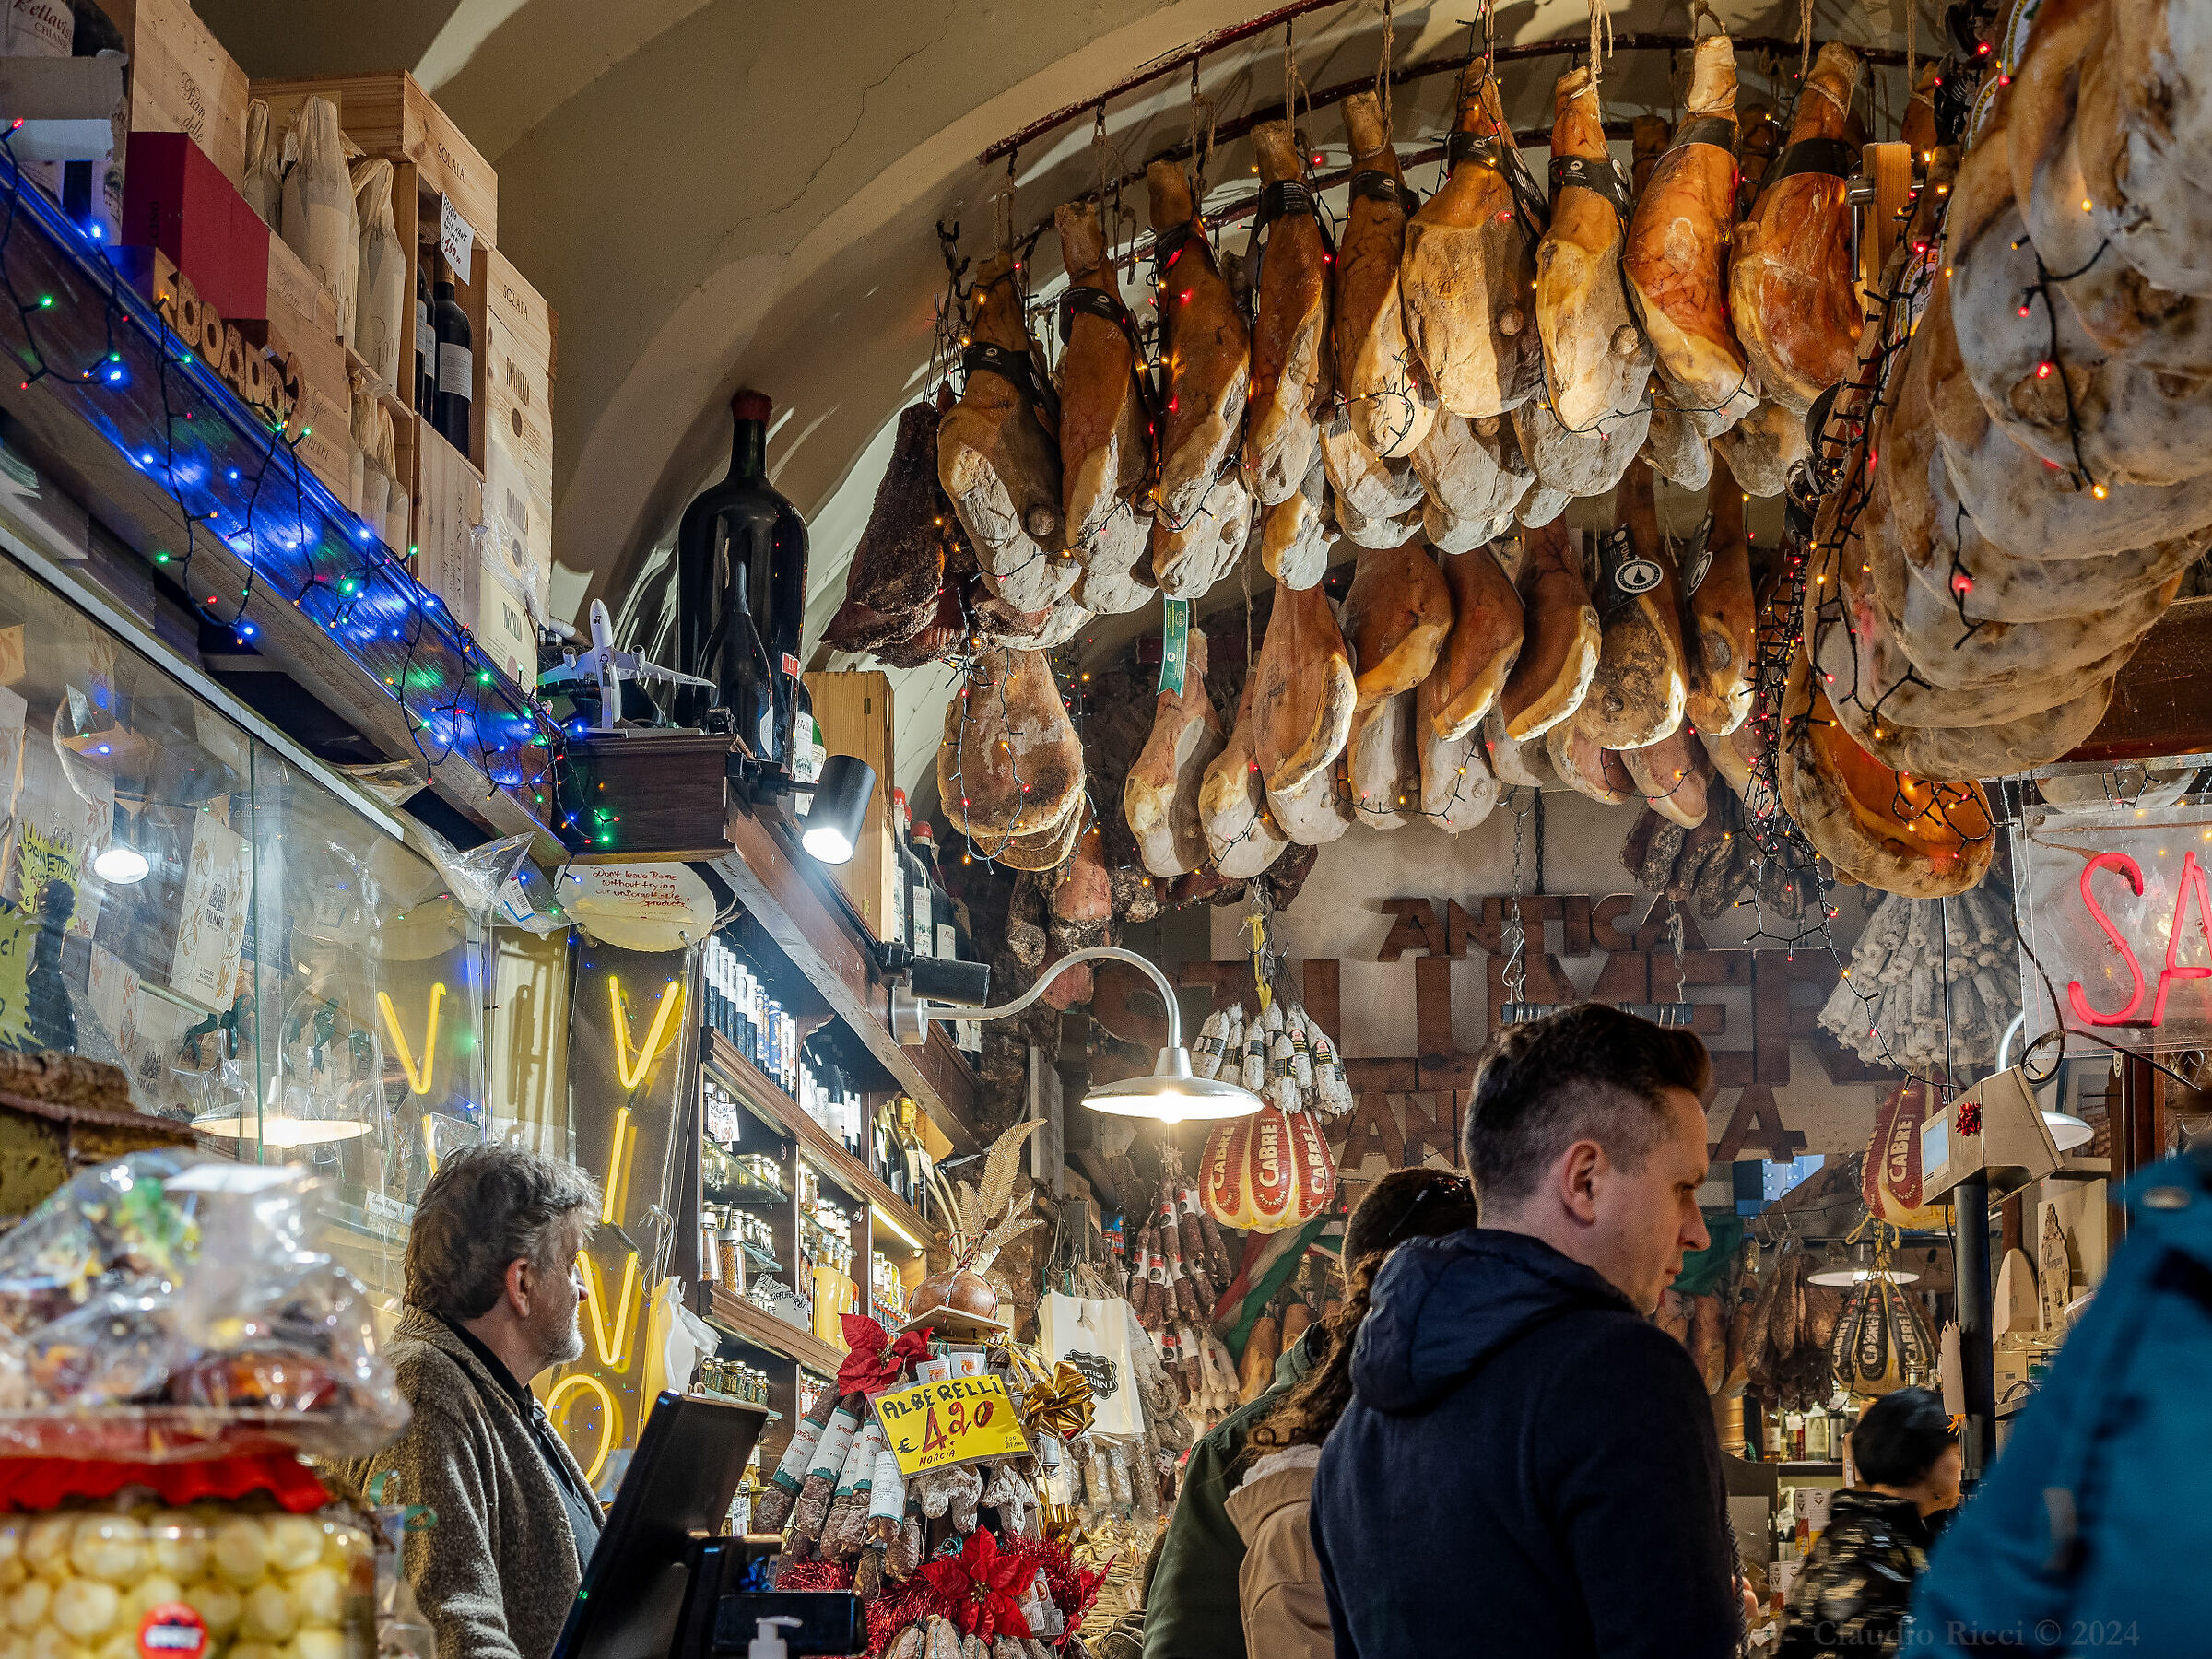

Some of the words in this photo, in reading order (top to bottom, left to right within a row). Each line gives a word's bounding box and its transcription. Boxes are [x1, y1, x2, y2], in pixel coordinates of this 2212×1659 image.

[437, 143, 465, 183] SOLAIA
[502, 284, 529, 320] SOLAIA
[1377, 890, 1709, 962] ANTICA
[1213, 1127, 1235, 1190] CABRE
[1259, 1124, 1279, 1187] CABRE
[1304, 1133, 1325, 1194] CABRE
[1888, 1119, 1913, 1183] CABRE
[881, 1376, 1002, 1420] ALBERELLI
[1077, 1367, 1106, 1380] OTTEGA
[918, 1449, 956, 1467] NORCIA
